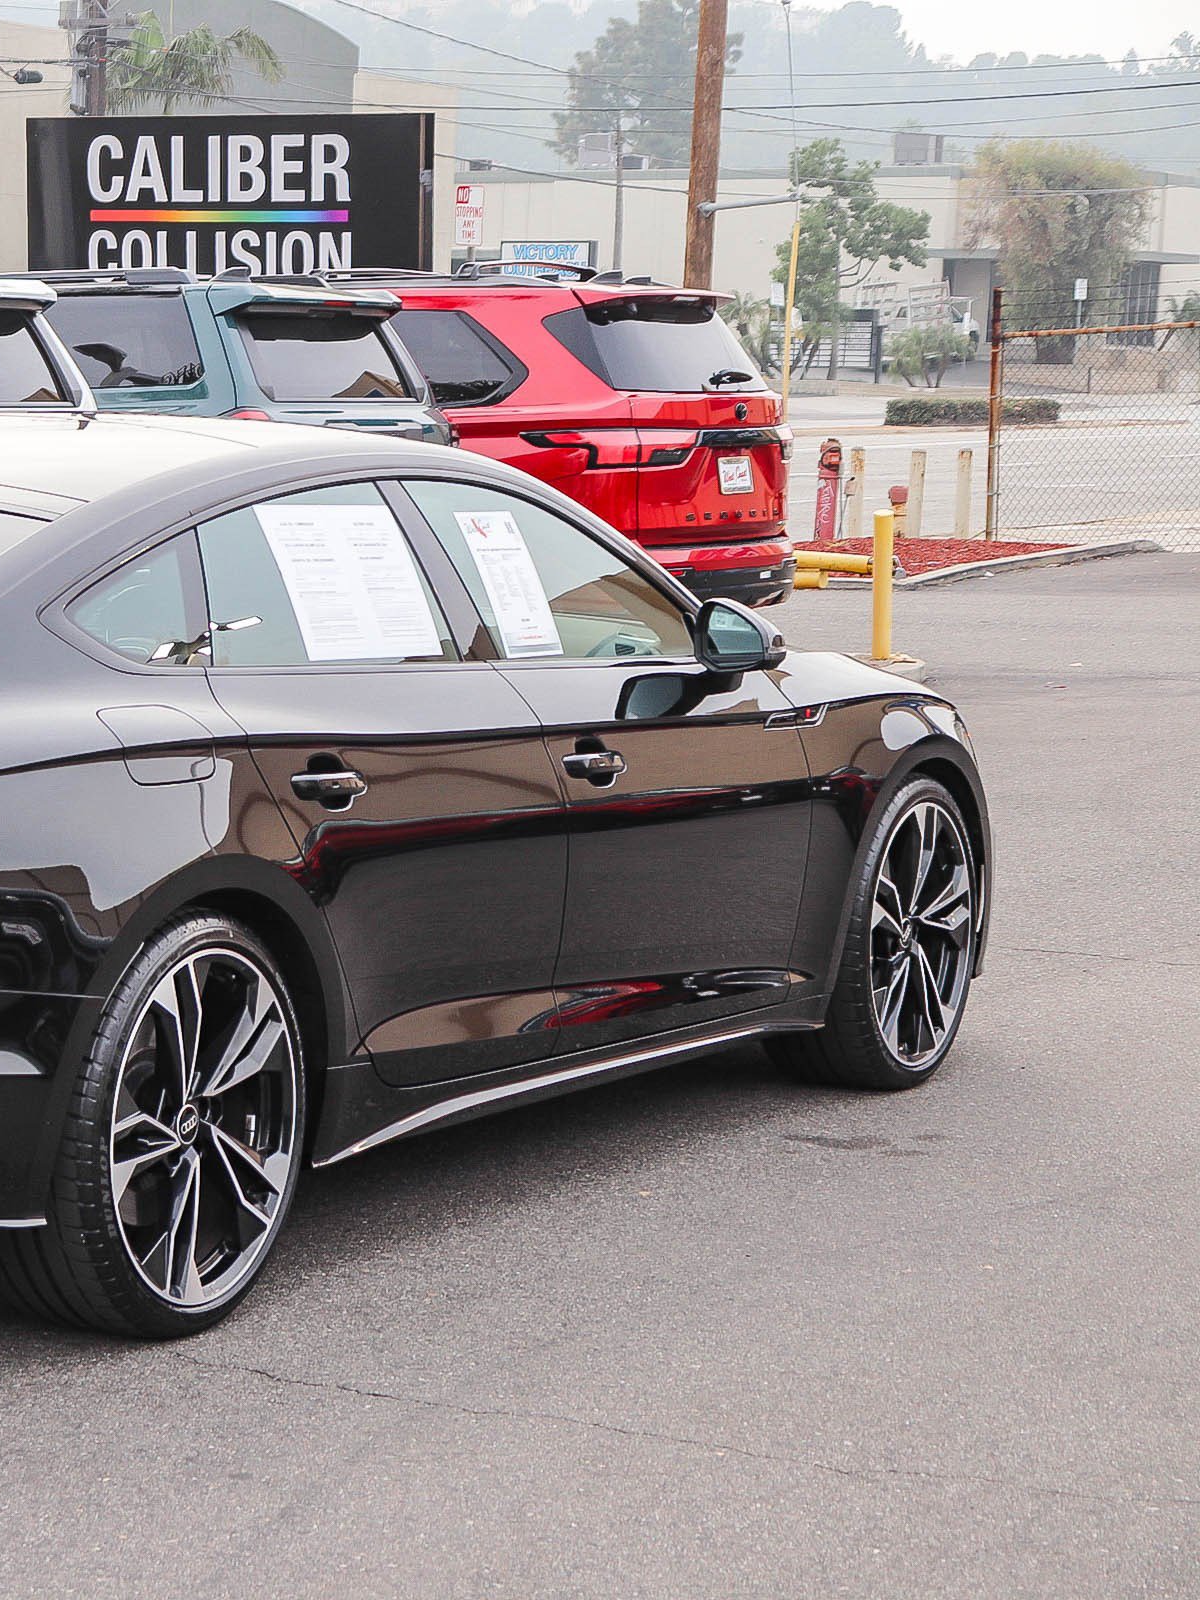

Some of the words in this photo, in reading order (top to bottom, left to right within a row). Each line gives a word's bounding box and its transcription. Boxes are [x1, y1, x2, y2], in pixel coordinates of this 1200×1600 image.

[86, 133, 352, 203] CALIBER
[456, 206, 483, 218] STOPPING
[462, 220, 475, 228] ANY
[462, 230, 476, 239] TIME
[88, 229, 352, 277] COLLISION
[513, 244, 579, 260] VICTORY
[503, 264, 579, 277] OUTR
